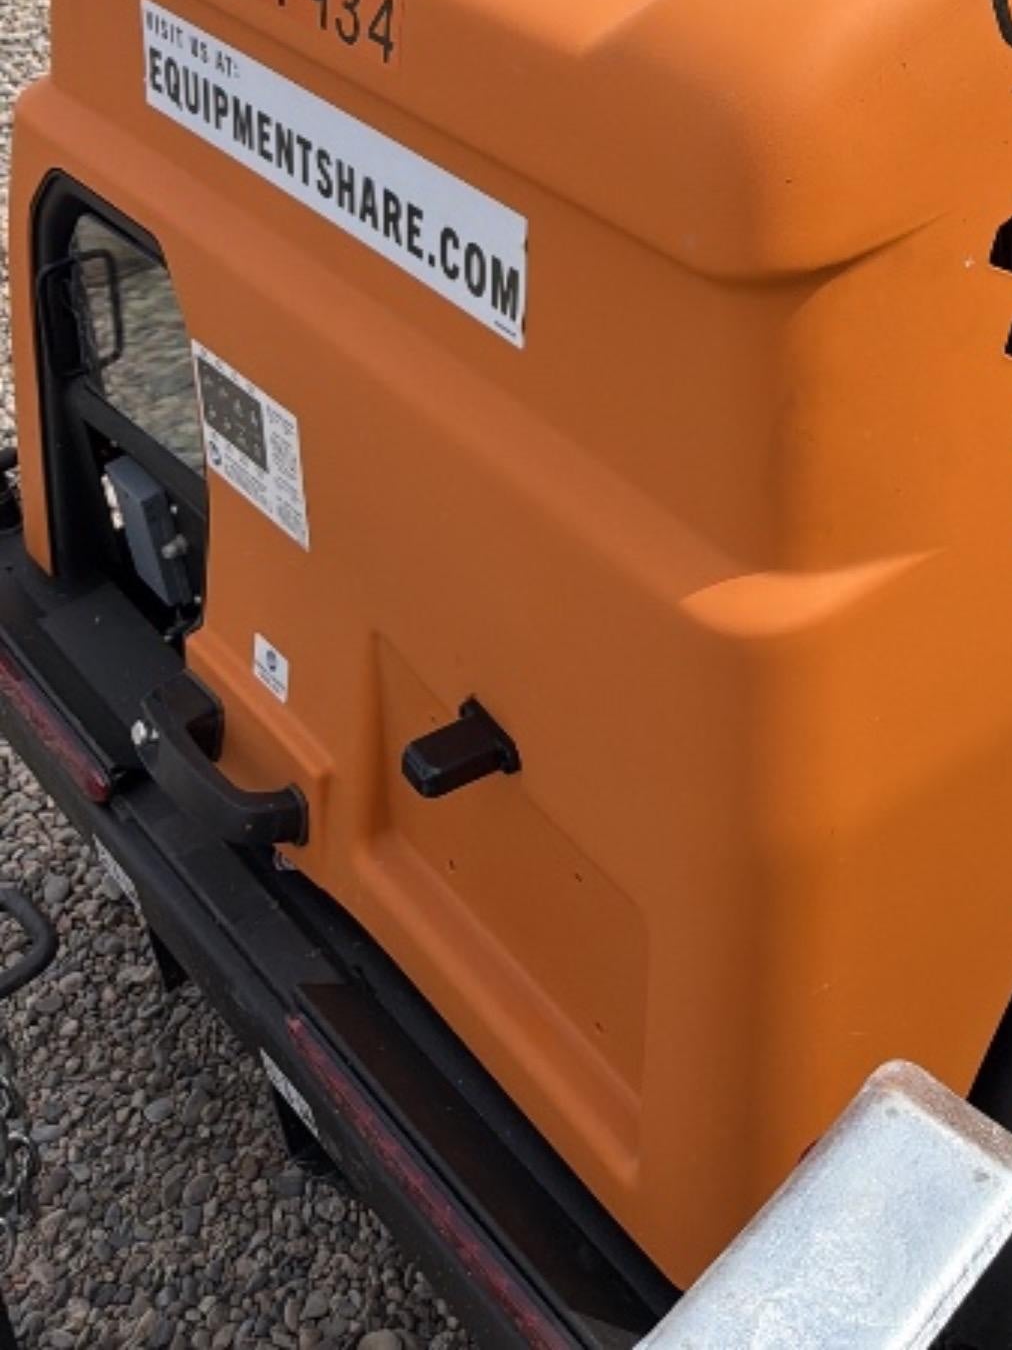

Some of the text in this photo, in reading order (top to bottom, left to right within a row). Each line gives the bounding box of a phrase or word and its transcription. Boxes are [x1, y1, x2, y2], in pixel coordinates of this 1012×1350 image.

[146, 11, 183, 48] VISIT
[190, 34, 208, 64] US
[147, 45, 520, 323] EQUIPMENTSHARE.COM
